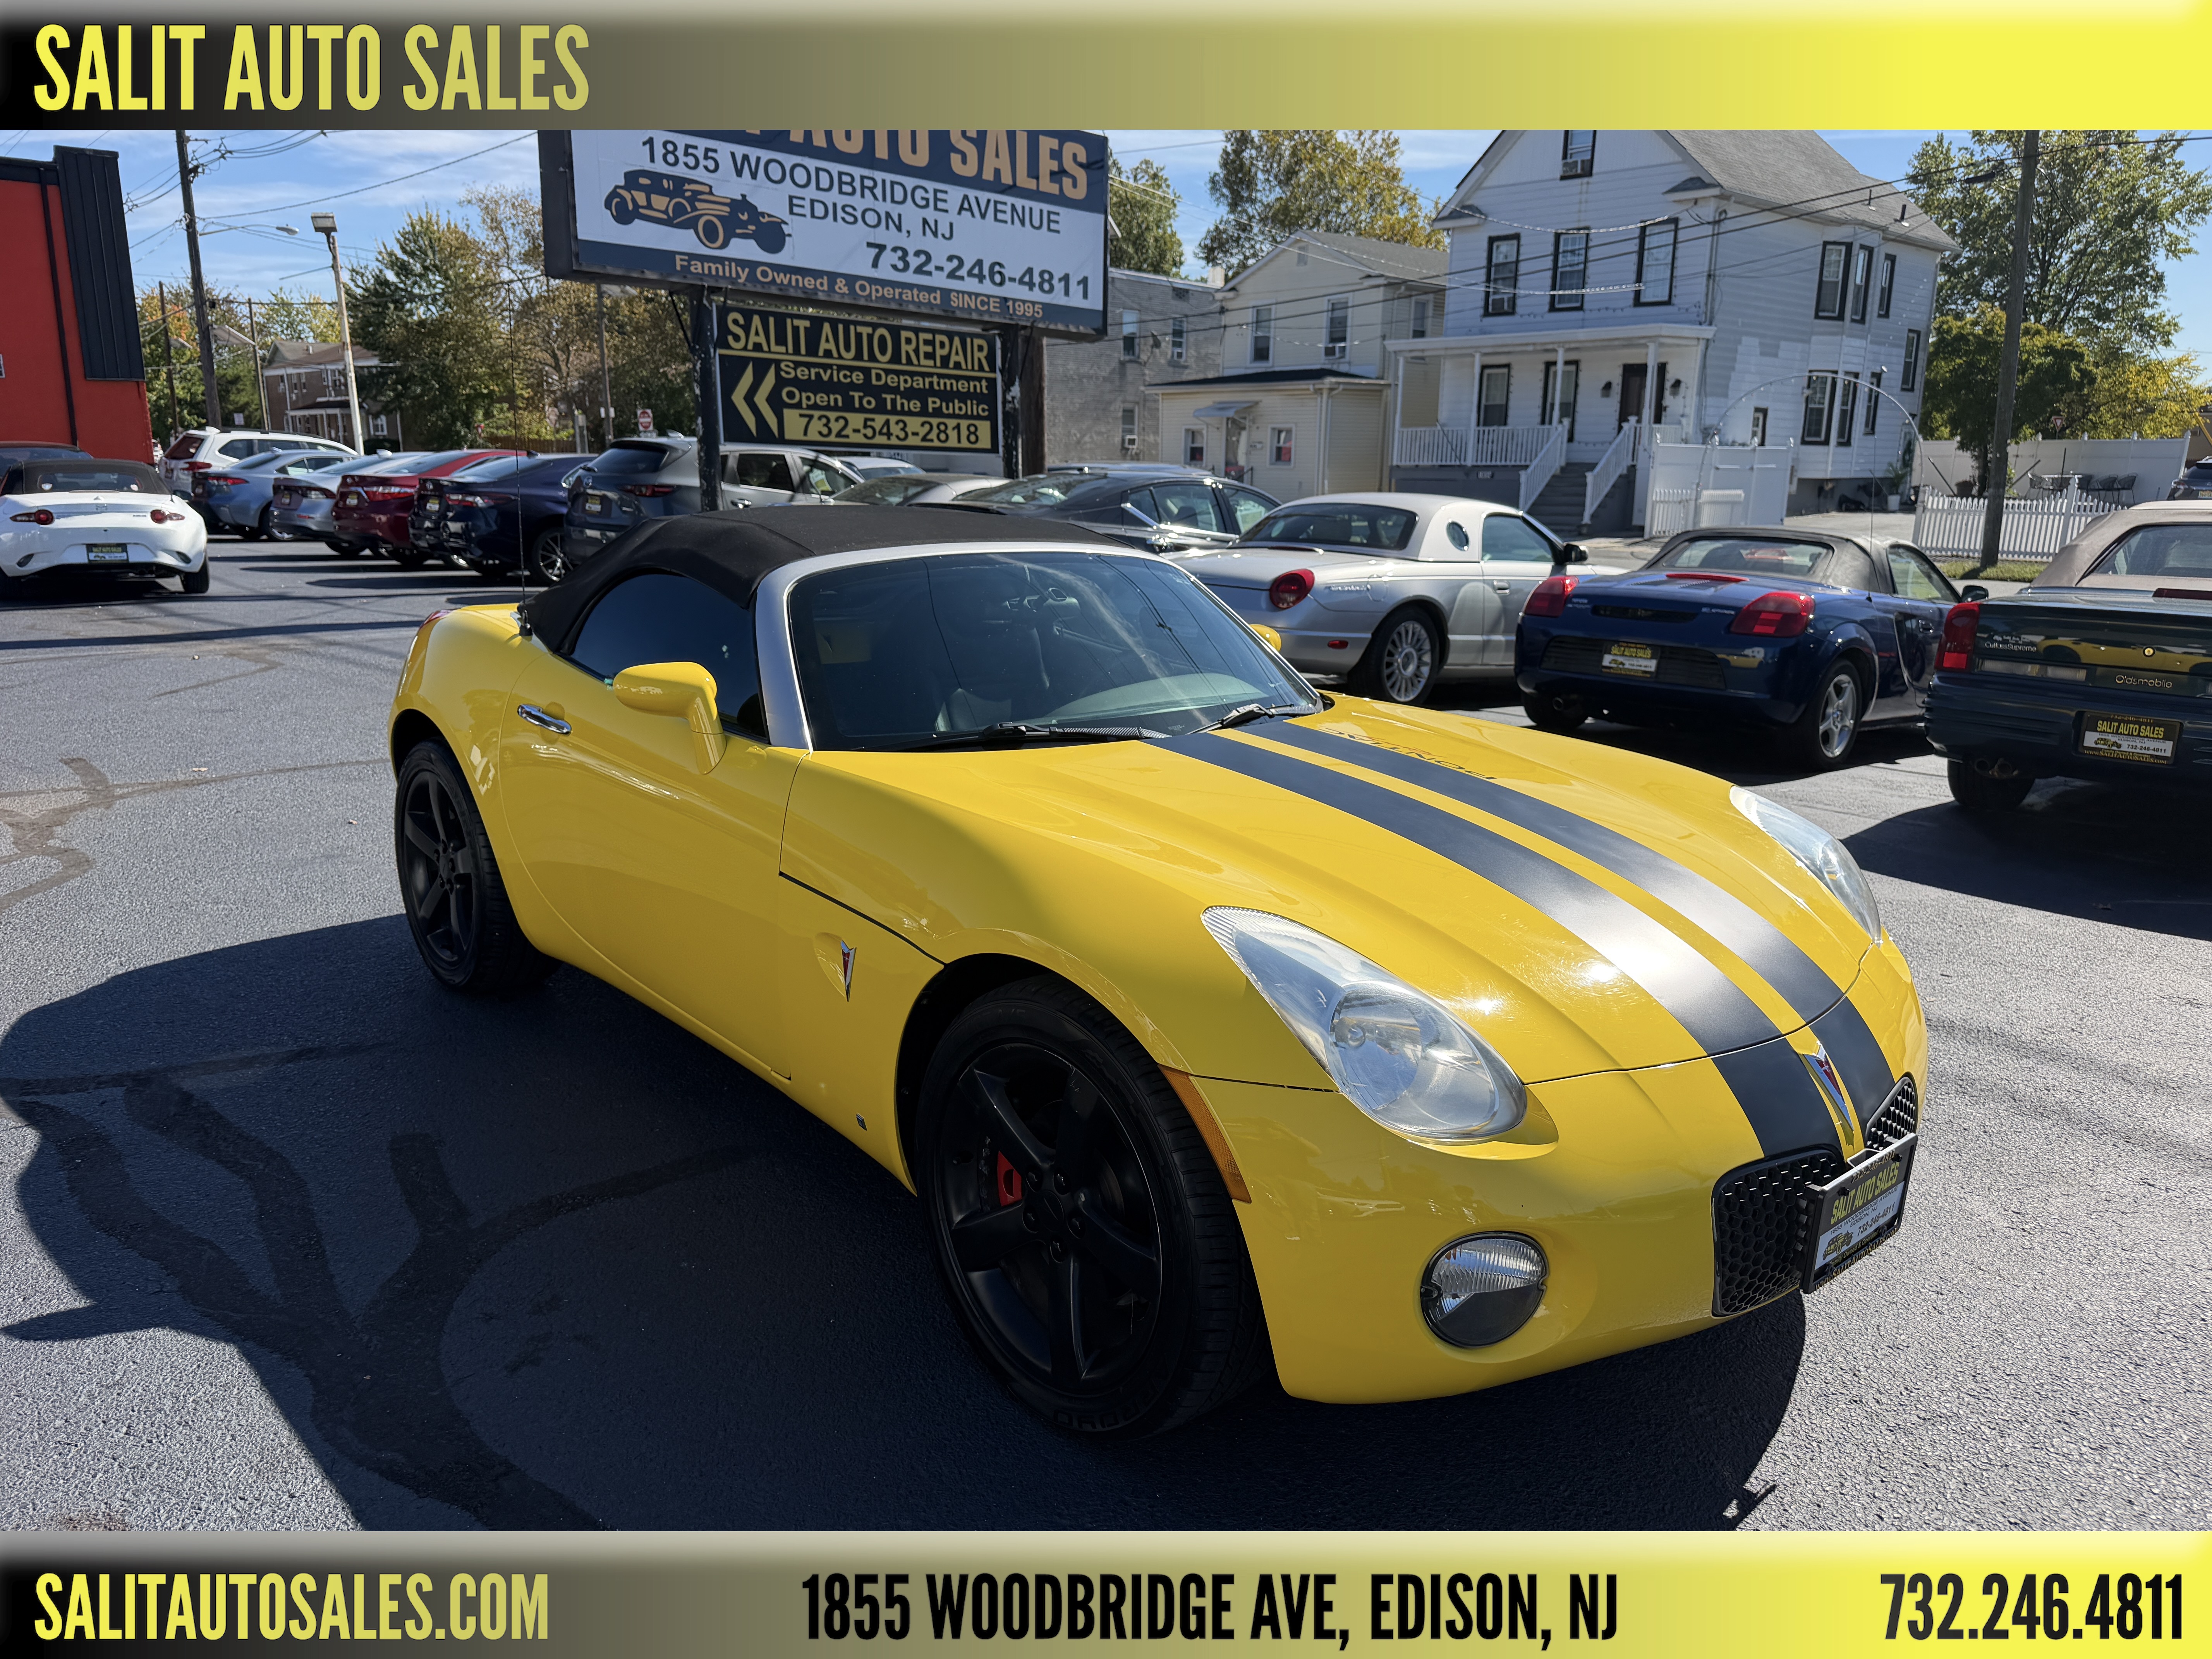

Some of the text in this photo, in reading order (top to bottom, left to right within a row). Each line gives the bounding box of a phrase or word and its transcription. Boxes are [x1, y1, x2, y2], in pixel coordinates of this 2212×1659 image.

[642, 137, 1061, 234] 1855 WOODBRIDGE AVENUE
[950, 130, 1088, 199] SALES
[788, 195, 954, 240] EDISON, NJ
[675, 254, 1043, 318] Family Owned & Operated SINCE 1995
[866, 242, 1089, 299] 732-246-4811
[727, 312, 990, 371] SALIT AUTO REPAIR
[780, 361, 988, 393] Service Department
[781, 387, 989, 416] Open To The Public
[799, 413, 979, 445] 732-543-2818
[2116, 675, 2172, 688] Oldsmobile
[2097, 720, 2164, 738] SALIT AUTO SALES
[1831, 1162, 1900, 1224] SALIT AUTO SALES
[1831, 1223, 1843, 1235] 1855
[1844, 1200, 1879, 1226] WOODBRIDGE
